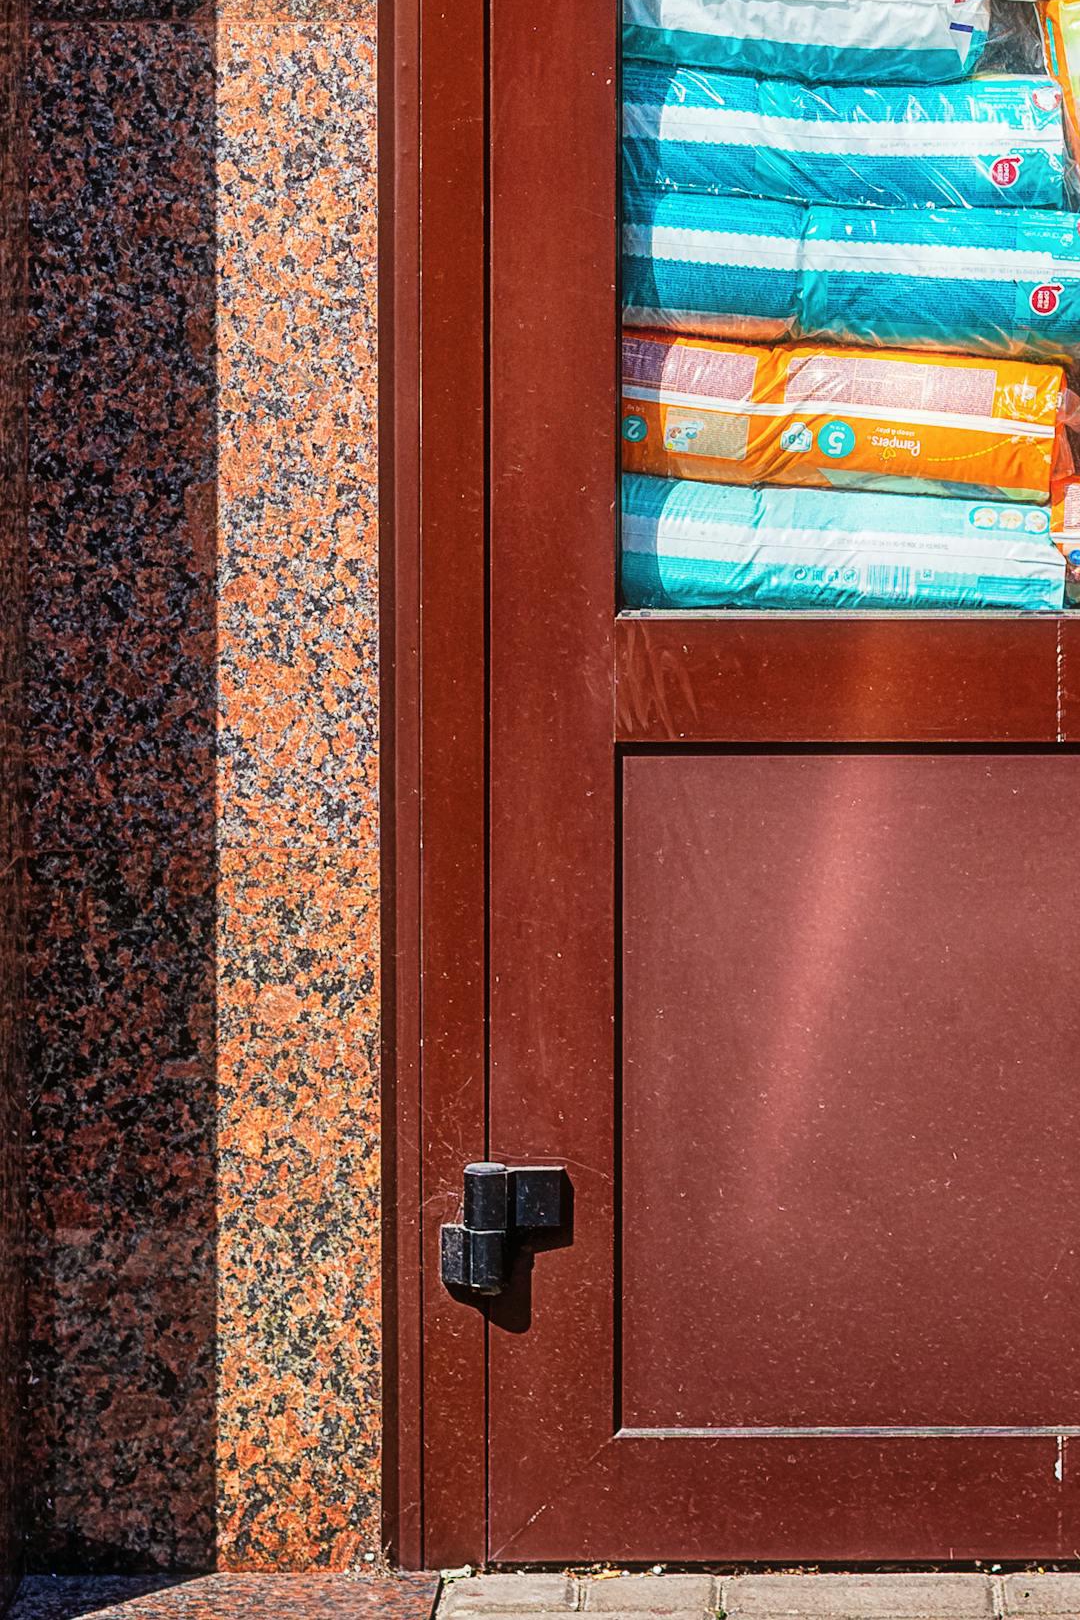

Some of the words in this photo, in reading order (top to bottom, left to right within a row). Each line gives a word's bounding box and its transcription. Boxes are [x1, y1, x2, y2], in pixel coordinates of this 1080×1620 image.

[628, 420, 641, 439] 2
[829, 431, 845, 454] 5
[870, 435, 921, 456] Pampers
